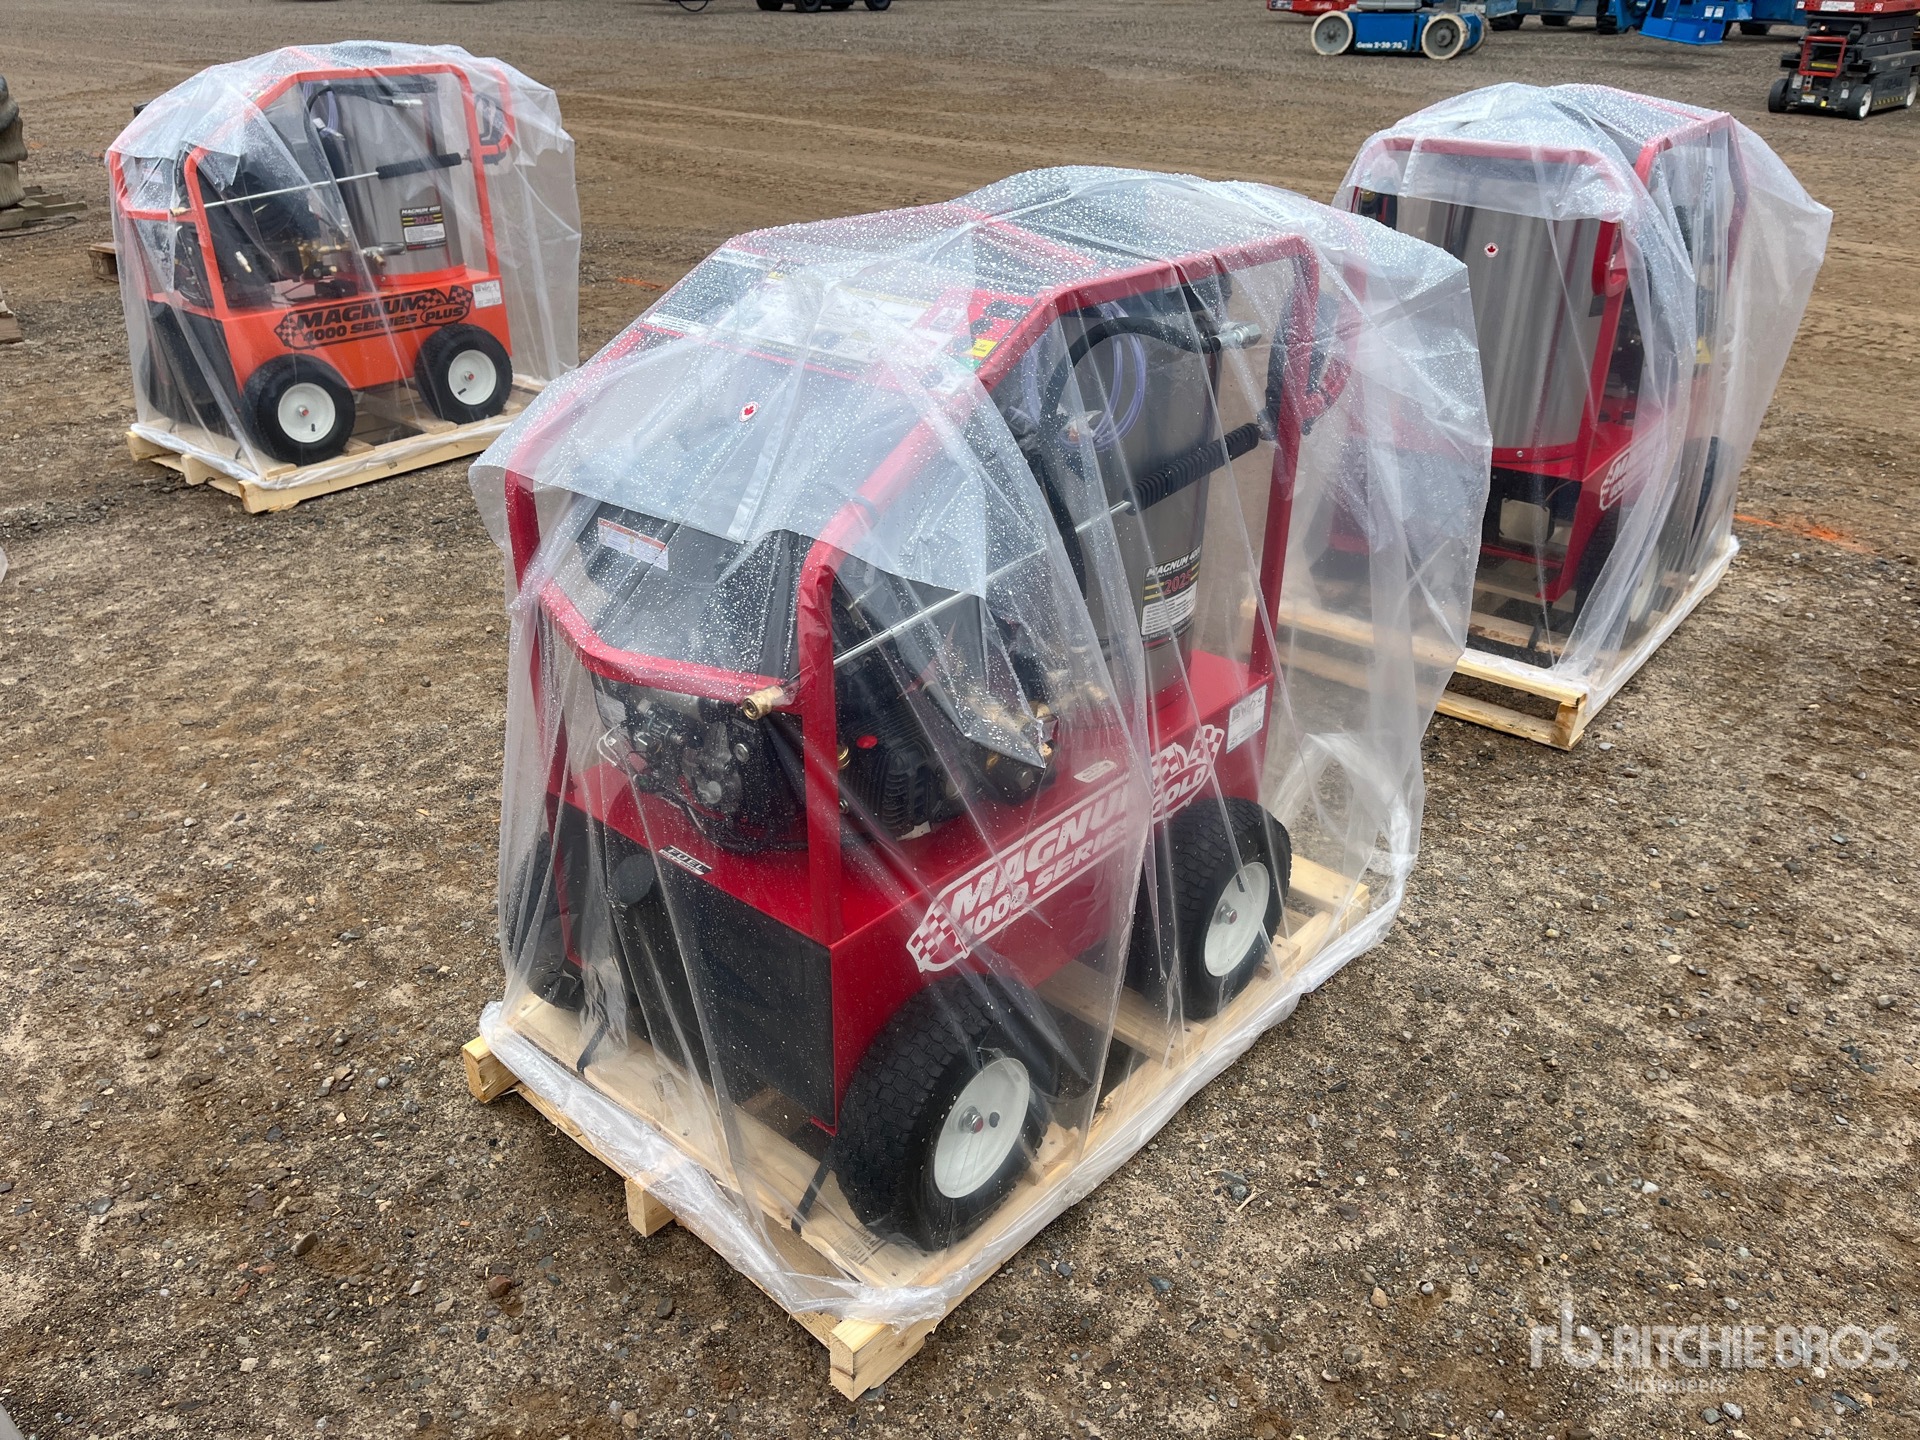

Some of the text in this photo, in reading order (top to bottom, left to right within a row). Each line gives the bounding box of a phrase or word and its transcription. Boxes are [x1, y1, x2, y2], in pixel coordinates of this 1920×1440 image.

[296, 295, 422, 330] MAGNUM
[425, 305, 465, 323] PLUS
[303, 312, 418, 342] 4000 SERIES
[1146, 555, 1188, 578] MAGNUM
[1163, 569, 1193, 595] 2025
[668, 848, 703, 872] FUEL
